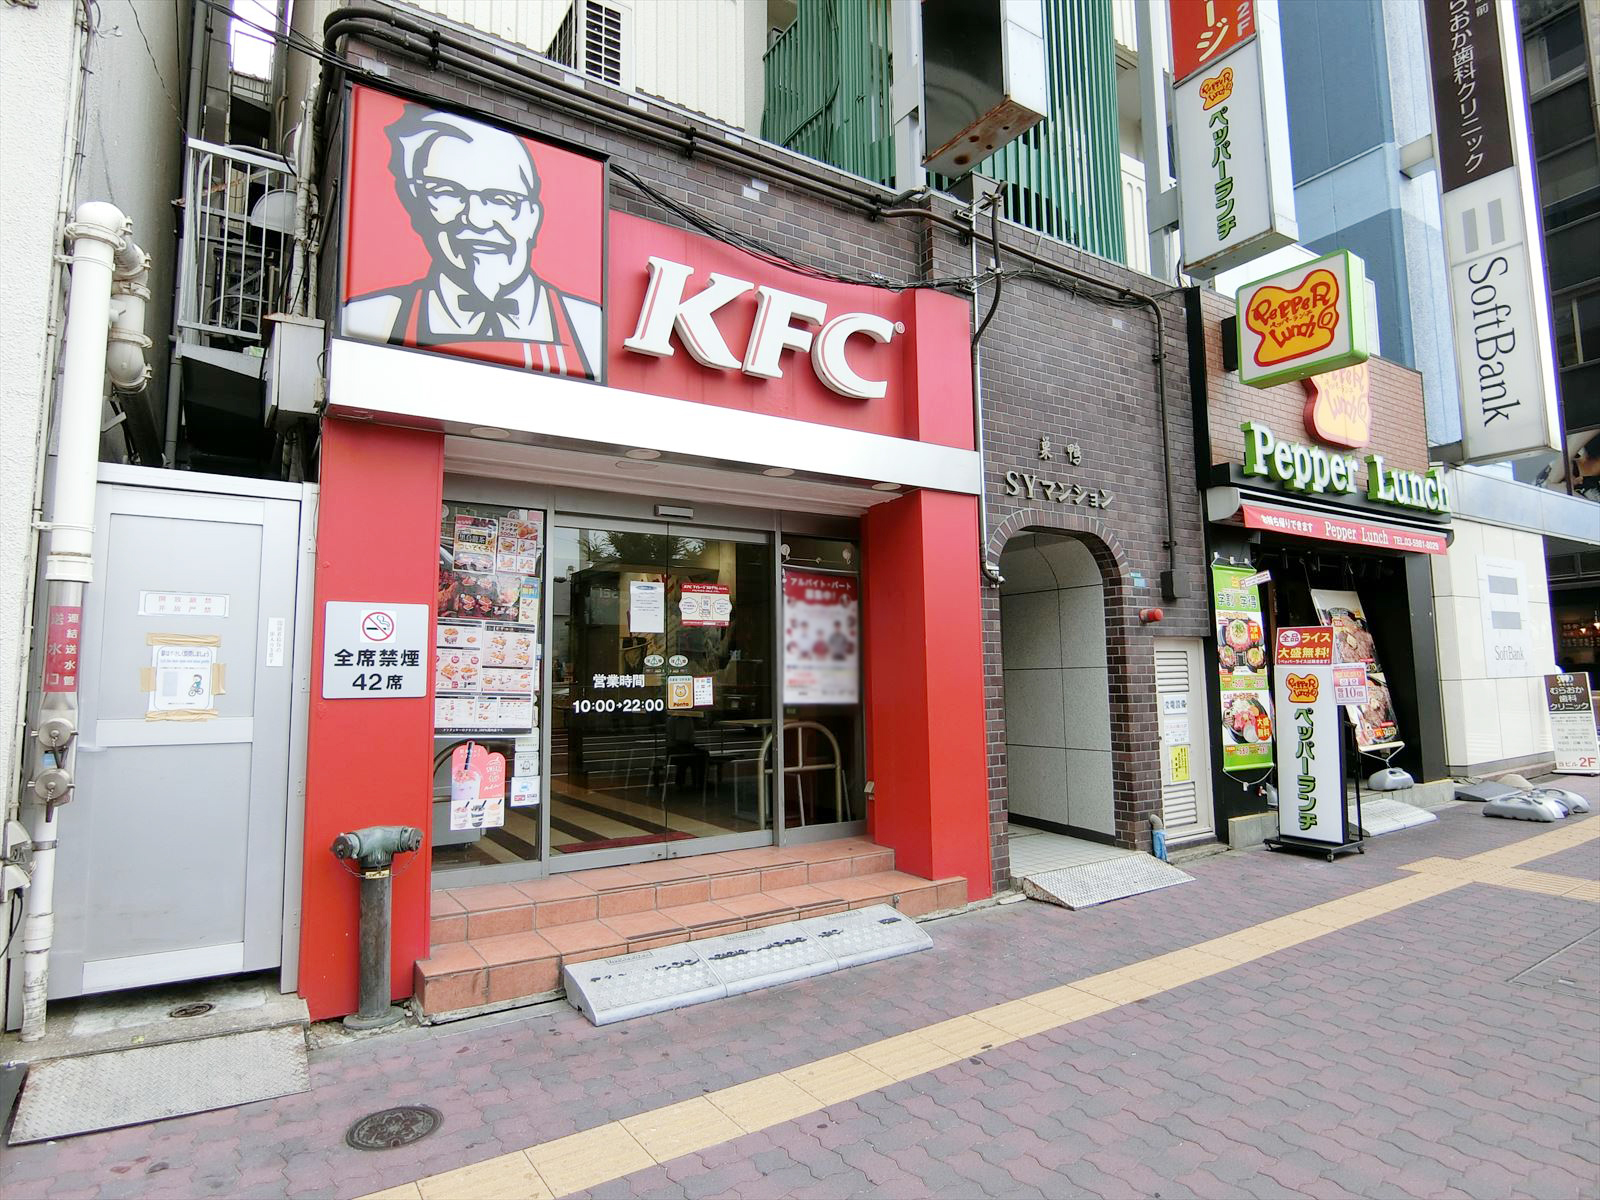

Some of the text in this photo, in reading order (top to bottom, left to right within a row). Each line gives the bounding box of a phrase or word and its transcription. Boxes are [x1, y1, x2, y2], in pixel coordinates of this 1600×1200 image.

[1197, 0, 1229, 62] ージ
[1237, 1, 1251, 37] 2F
[1209, 106, 1236, 241] ペッパーランチ
[623, 255, 896, 400] KFC
[1468, 256, 1521, 427] SoftBank
[1242, 421, 1450, 513] Pepper Lunch
[1005, 470, 1115, 510] SYマンション
[1324, 521, 1357, 541] Pepper
[1361, 527, 1389, 545] Lunch
[63, 612, 79, 686] 連結送水管
[1280, 631, 1331, 643] 全品 ライス
[334, 648, 420, 667] 全席禁煙
[1495, 645, 1525, 661] SoftBank
[352, 673, 404, 691] 42席
[592, 673, 645, 689] 営業時間
[1550, 686, 1585, 695] むらおか
[1550, 702, 1589, 711] クリニック
[1558, 694, 1578, 703] 歯科
[1294, 707, 1318, 831] ペッパーランチ
[1579, 757, 1597, 768] 2F
